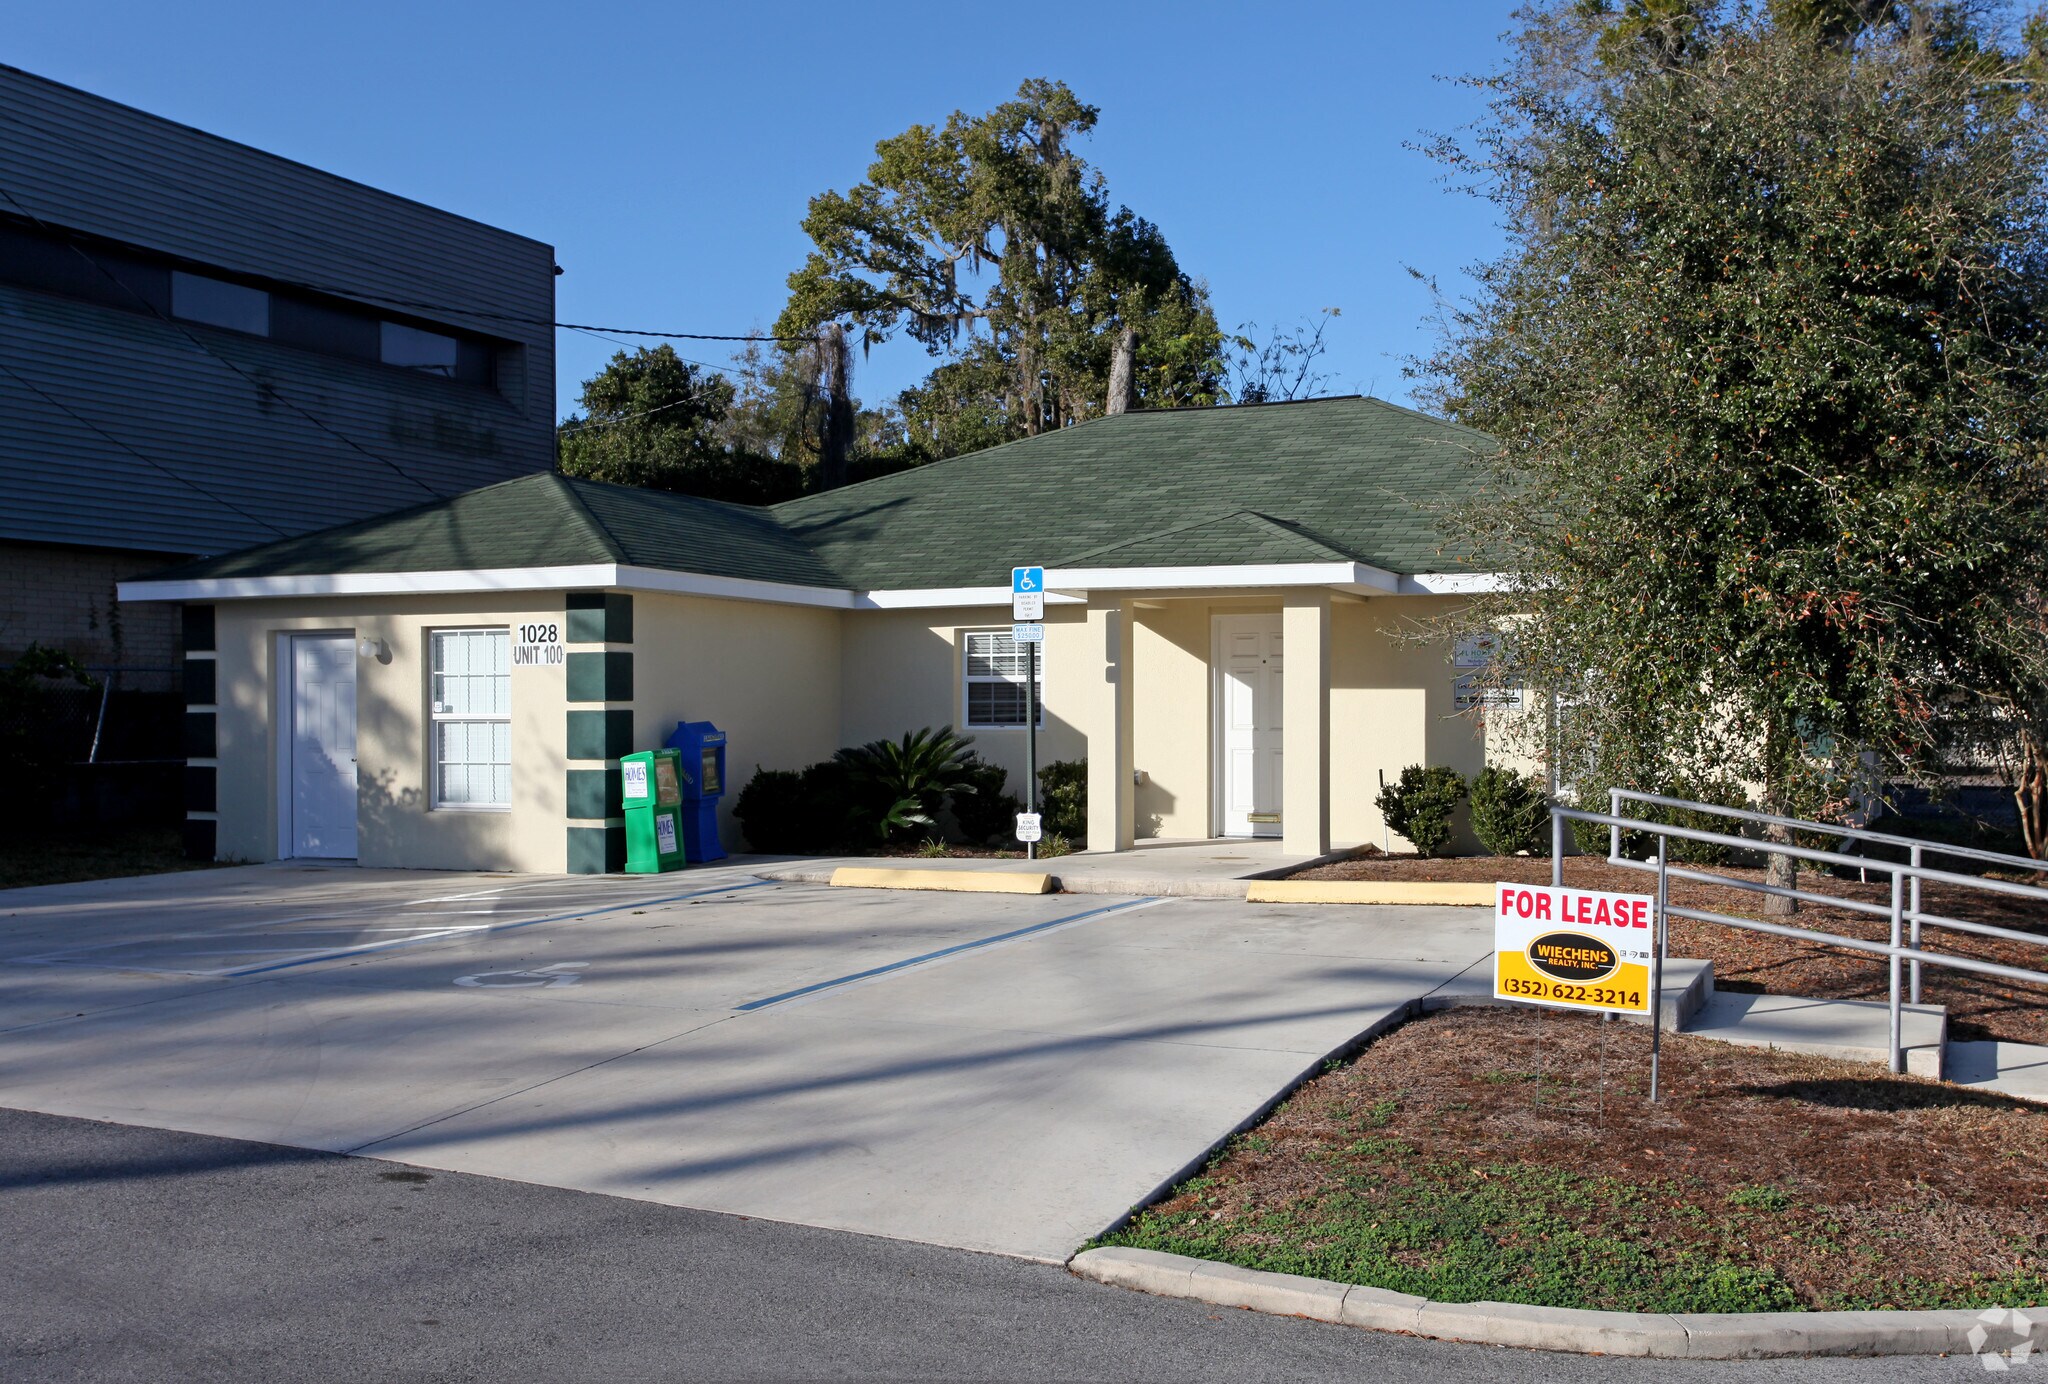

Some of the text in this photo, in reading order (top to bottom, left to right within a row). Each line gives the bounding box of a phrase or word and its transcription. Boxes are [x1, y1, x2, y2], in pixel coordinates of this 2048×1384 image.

[519, 624, 558, 643] 1028
[514, 645, 562, 665] UNIT 100
[625, 766, 646, 782] HOMES
[657, 818, 674, 836] HOMES
[1501, 889, 1648, 929] FOR LEASE
[1537, 944, 1609, 963] WIECHENS
[1548, 957, 1599, 970] REALTY, INC.
[1504, 978, 1641, 1006] (352) 622-3214
